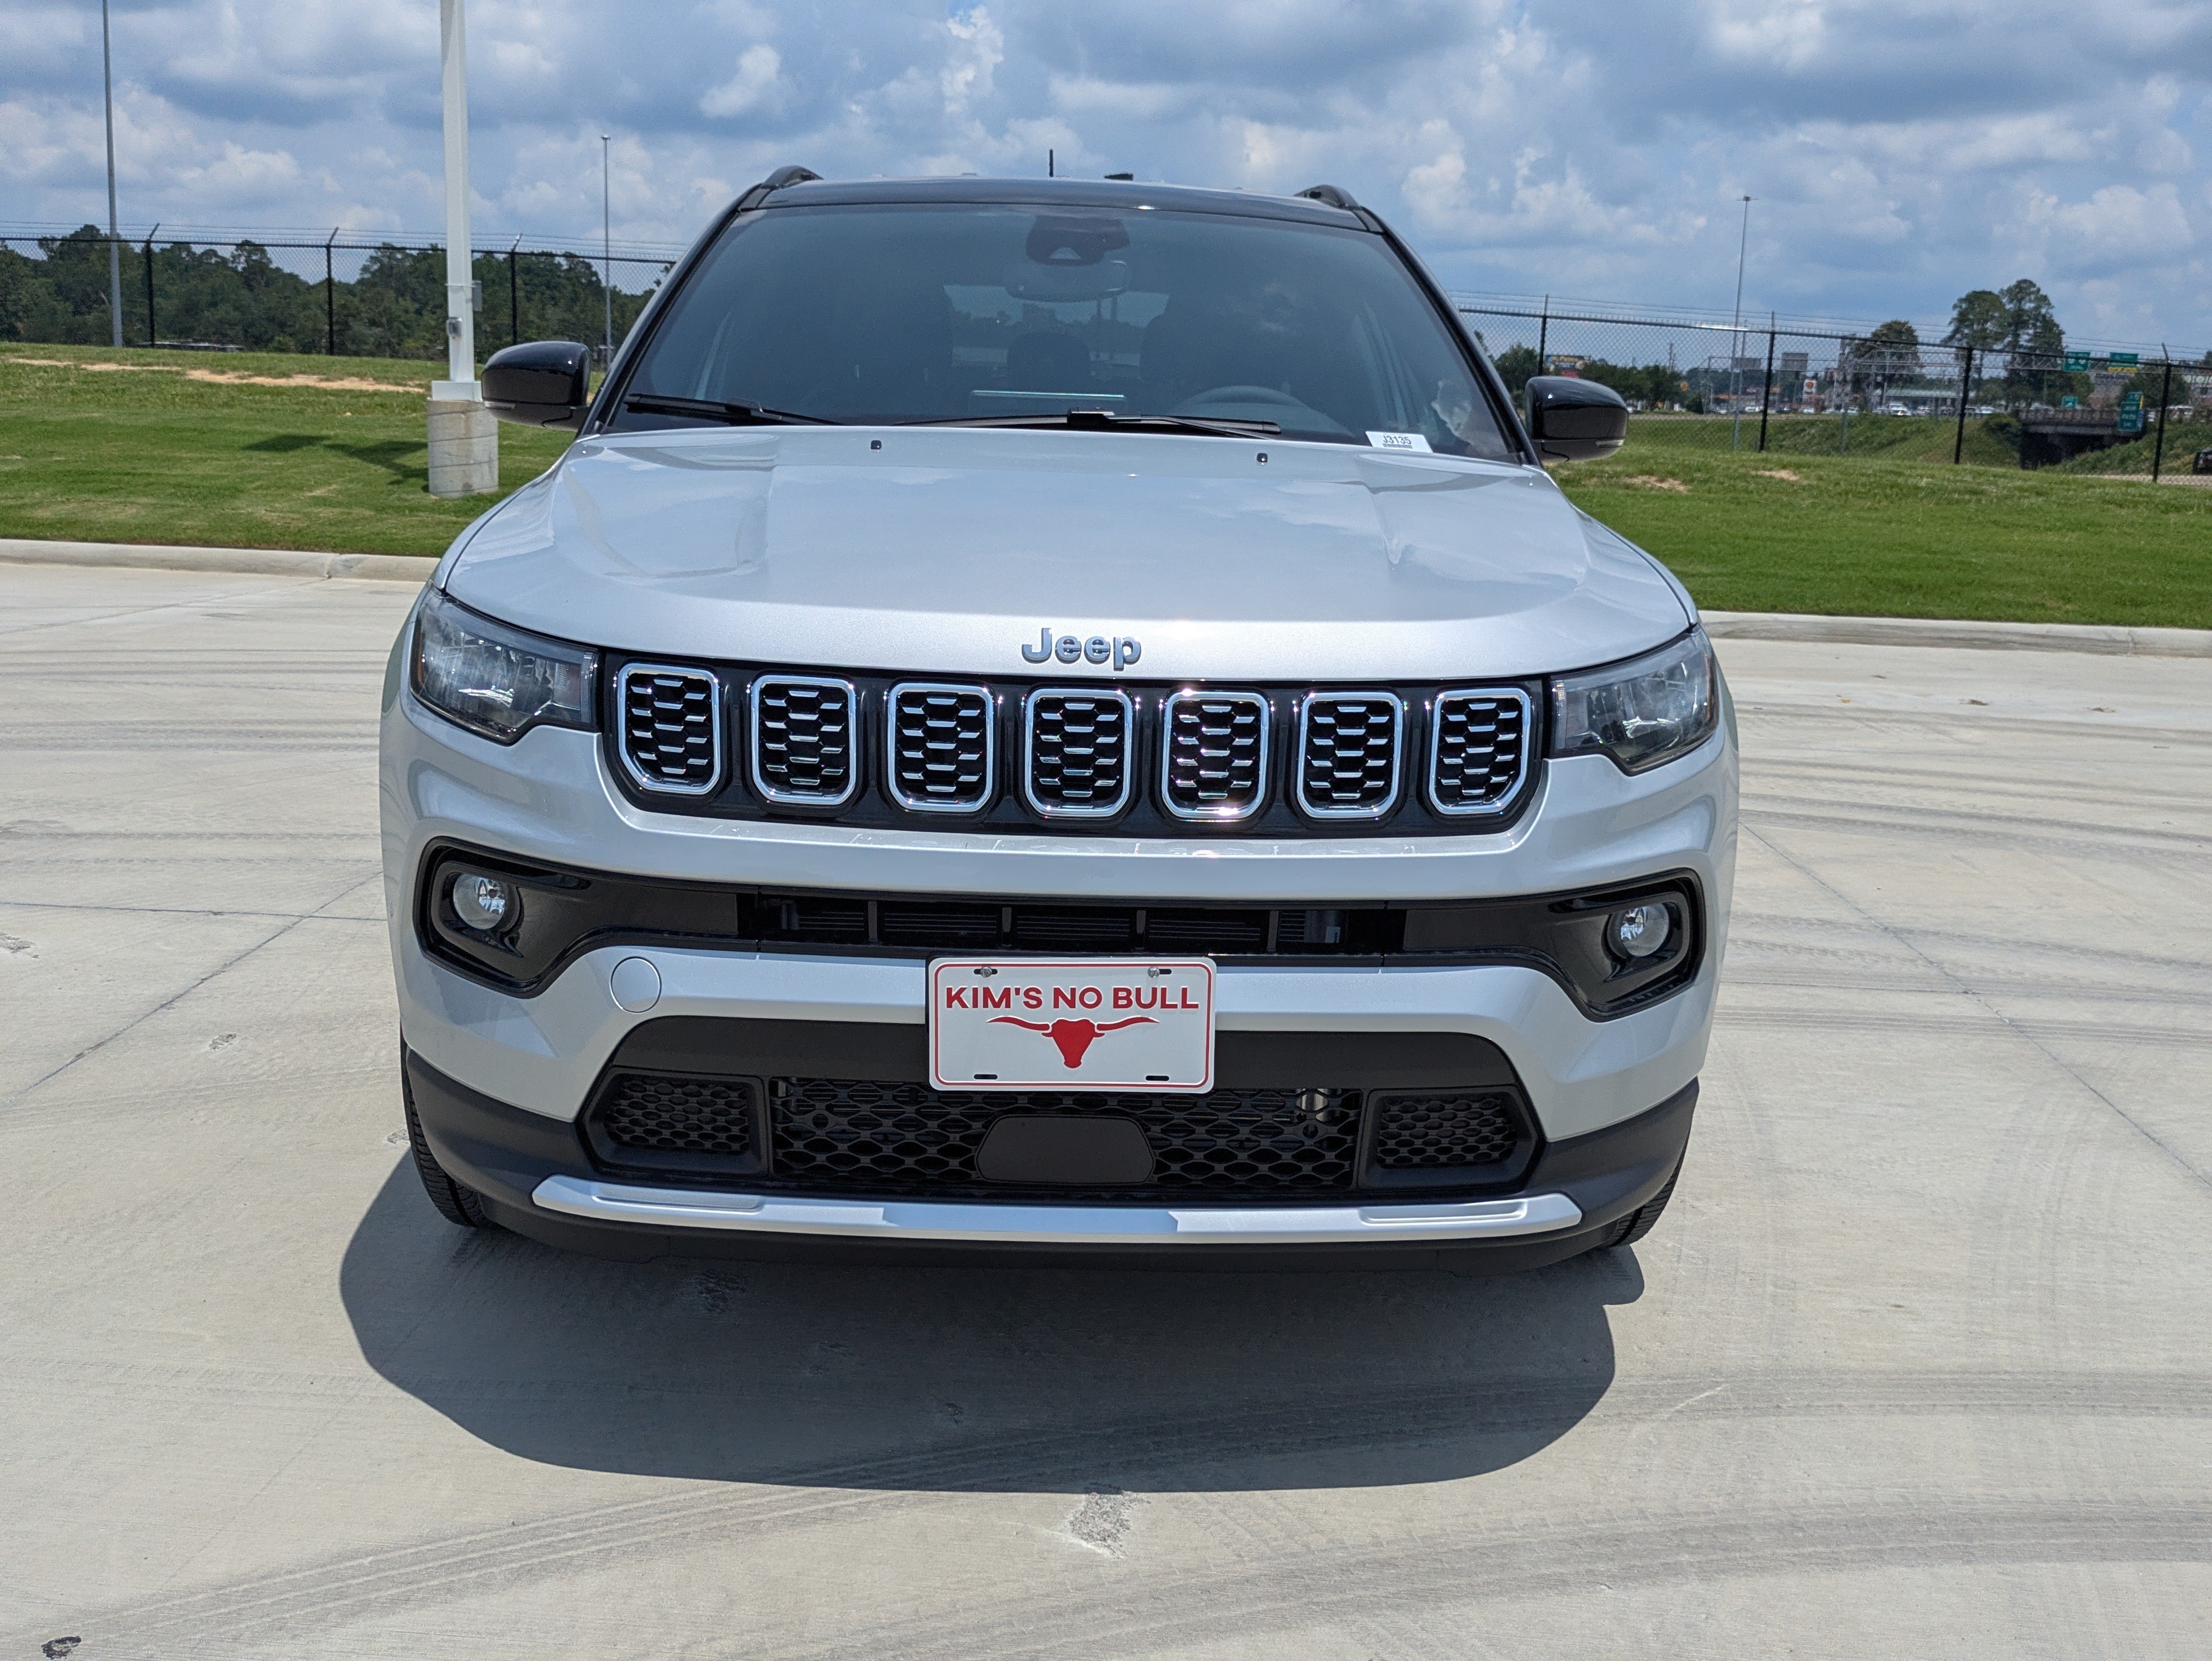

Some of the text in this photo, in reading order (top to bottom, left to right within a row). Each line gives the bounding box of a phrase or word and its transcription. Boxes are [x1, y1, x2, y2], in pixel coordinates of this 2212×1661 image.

[1383, 435, 1412, 444] J3135
[1021, 628, 1141, 671] Jeep
[946, 986, 1199, 1009] KIM'S NO BULL
